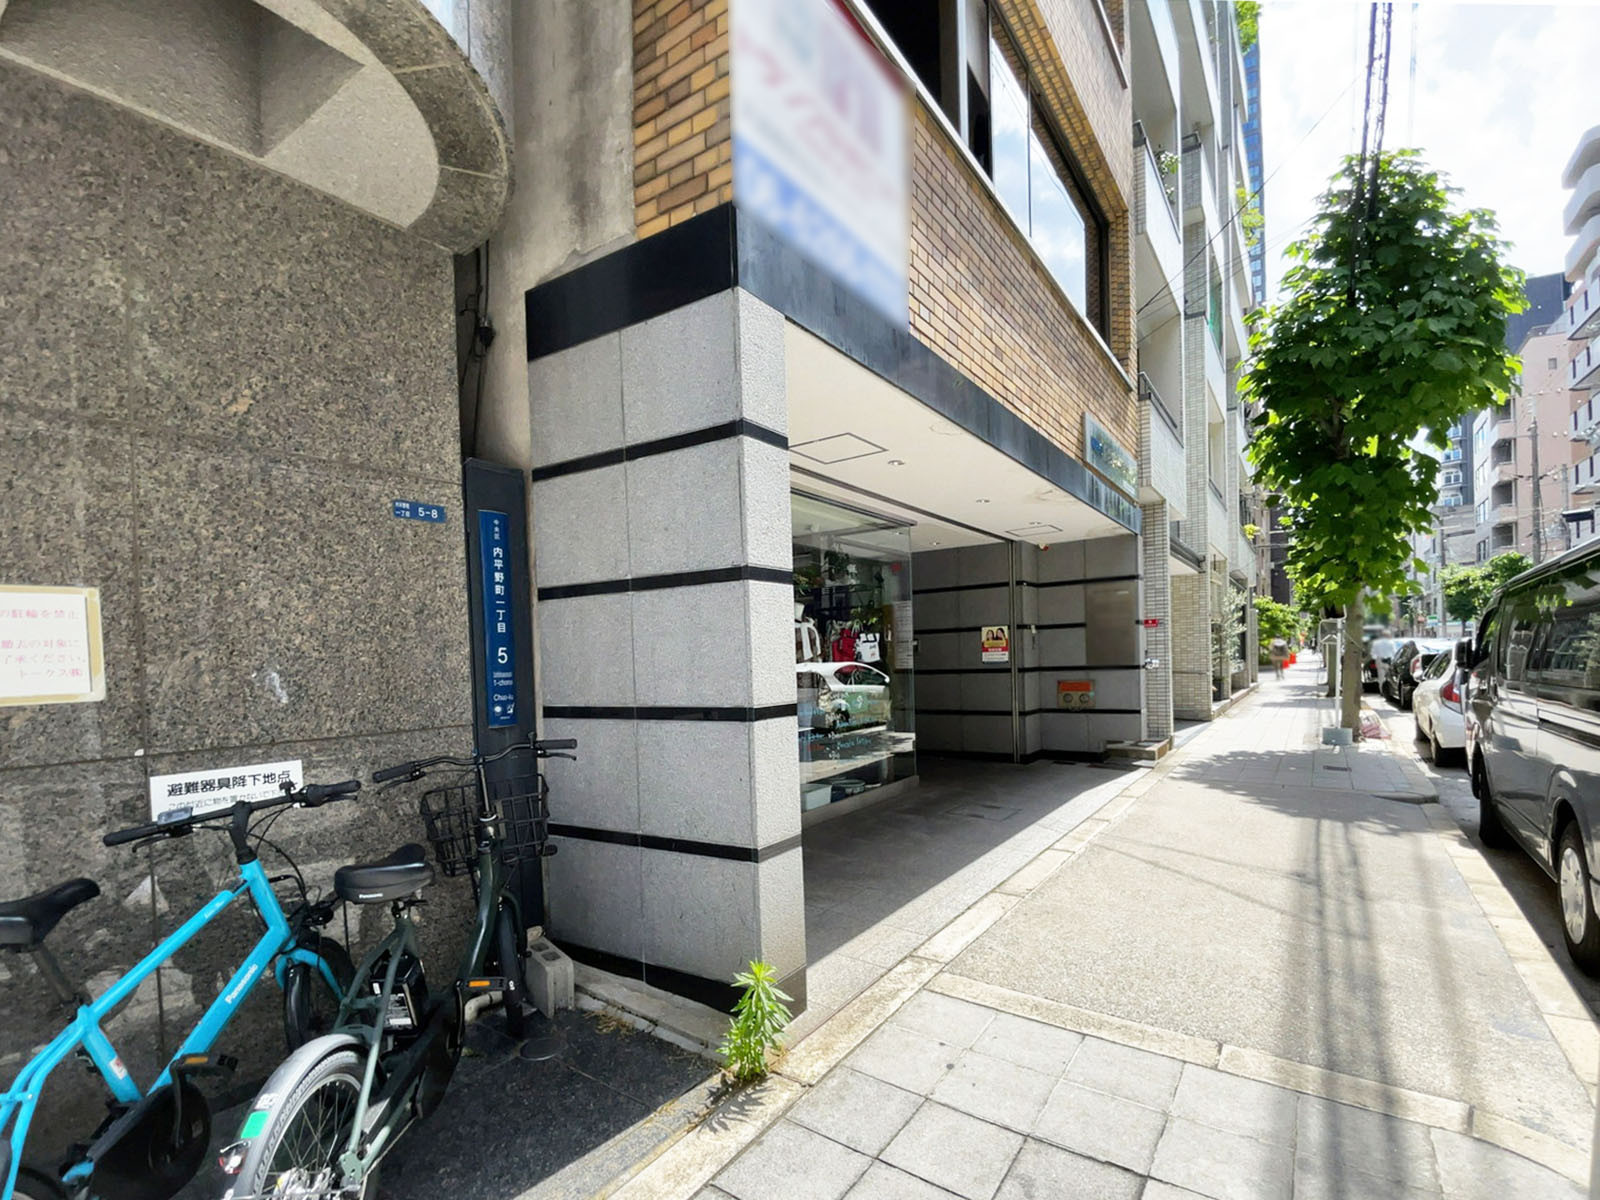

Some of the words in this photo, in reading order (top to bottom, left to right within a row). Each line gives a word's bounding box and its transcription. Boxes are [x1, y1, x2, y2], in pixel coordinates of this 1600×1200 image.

[418, 507, 438, 519] 5-8
[493, 547, 506, 633] 内平野町一丁目
[497, 646, 508, 664] 5
[167, 770, 292, 797] 避難器具降下地点
